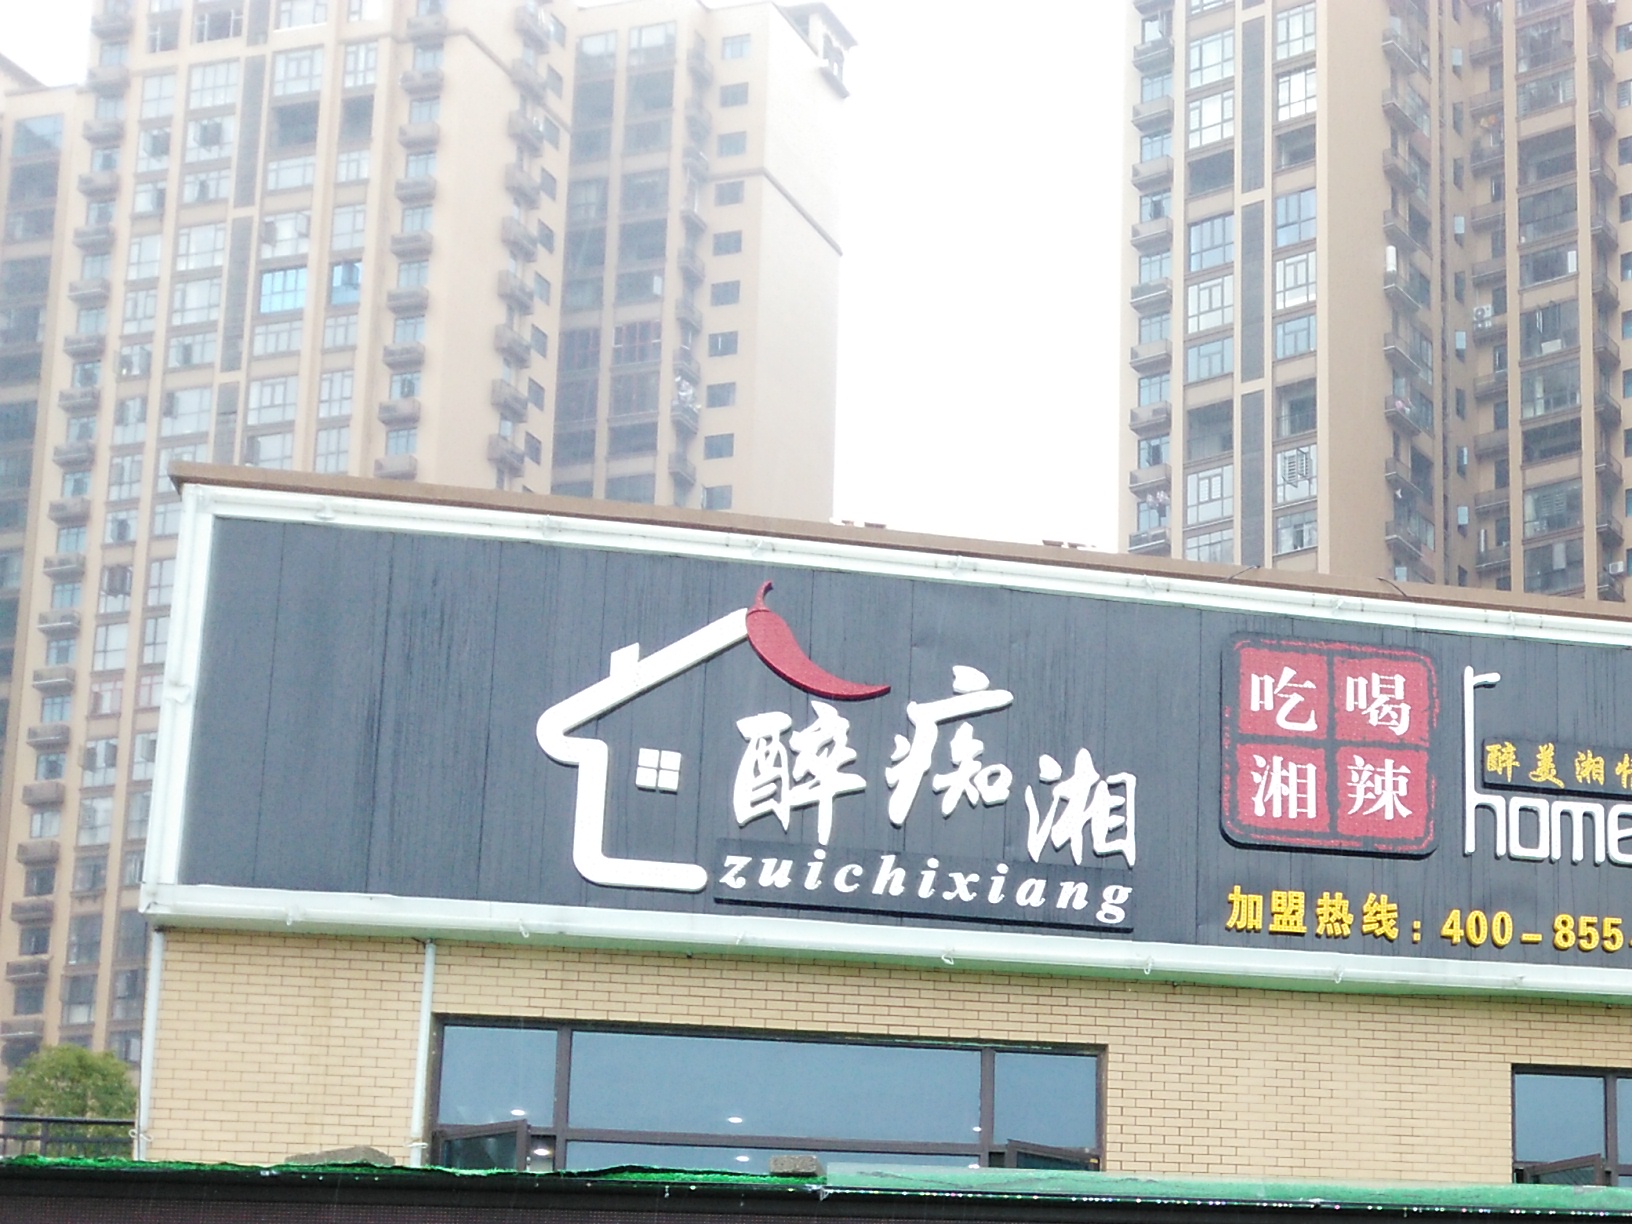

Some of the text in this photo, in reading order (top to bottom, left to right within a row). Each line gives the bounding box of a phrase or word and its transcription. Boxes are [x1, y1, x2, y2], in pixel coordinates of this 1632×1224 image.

[731, 665, 1137, 867] 醉痴湘
[719, 848, 1134, 924] zuichixiang
